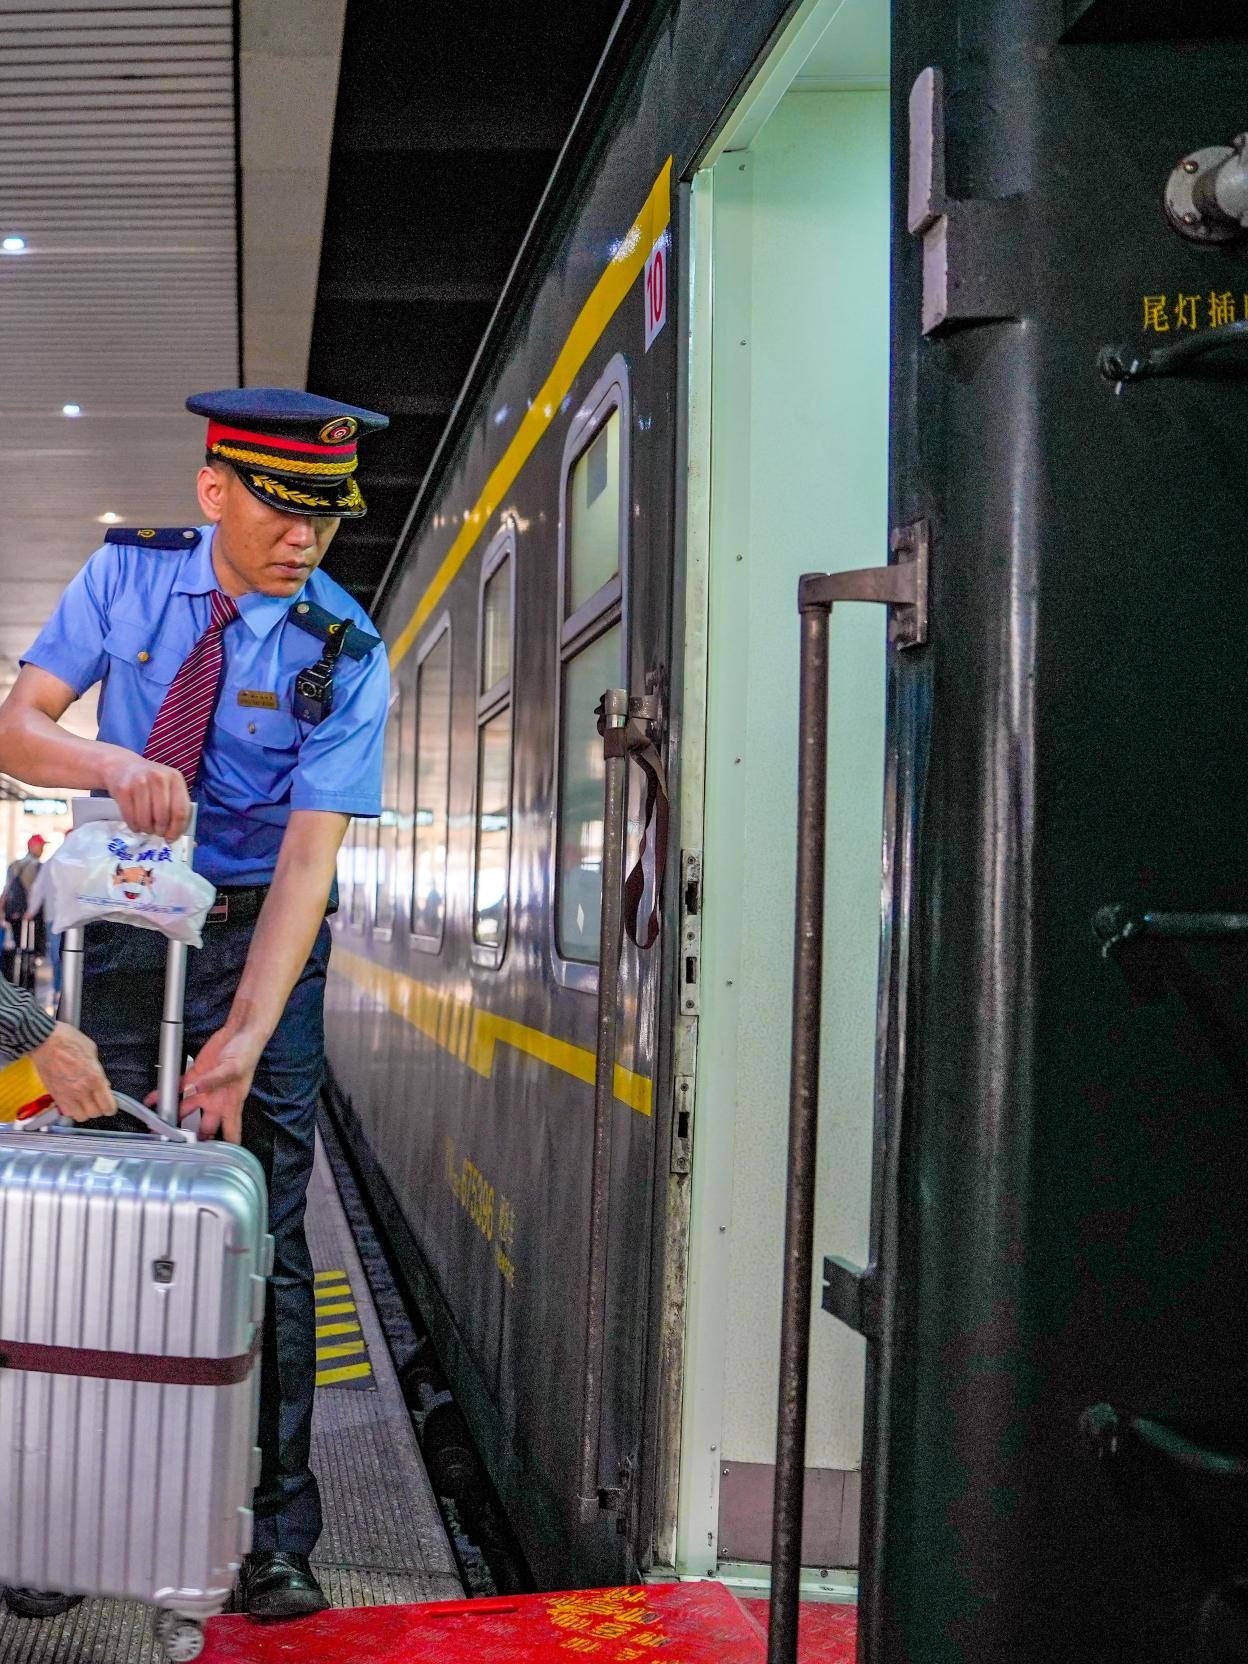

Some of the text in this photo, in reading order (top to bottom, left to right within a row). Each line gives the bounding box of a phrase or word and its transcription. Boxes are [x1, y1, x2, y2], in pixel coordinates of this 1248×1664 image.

[647, 251, 663, 332] 10
[1143, 291, 1248, 332] 尾灯插
